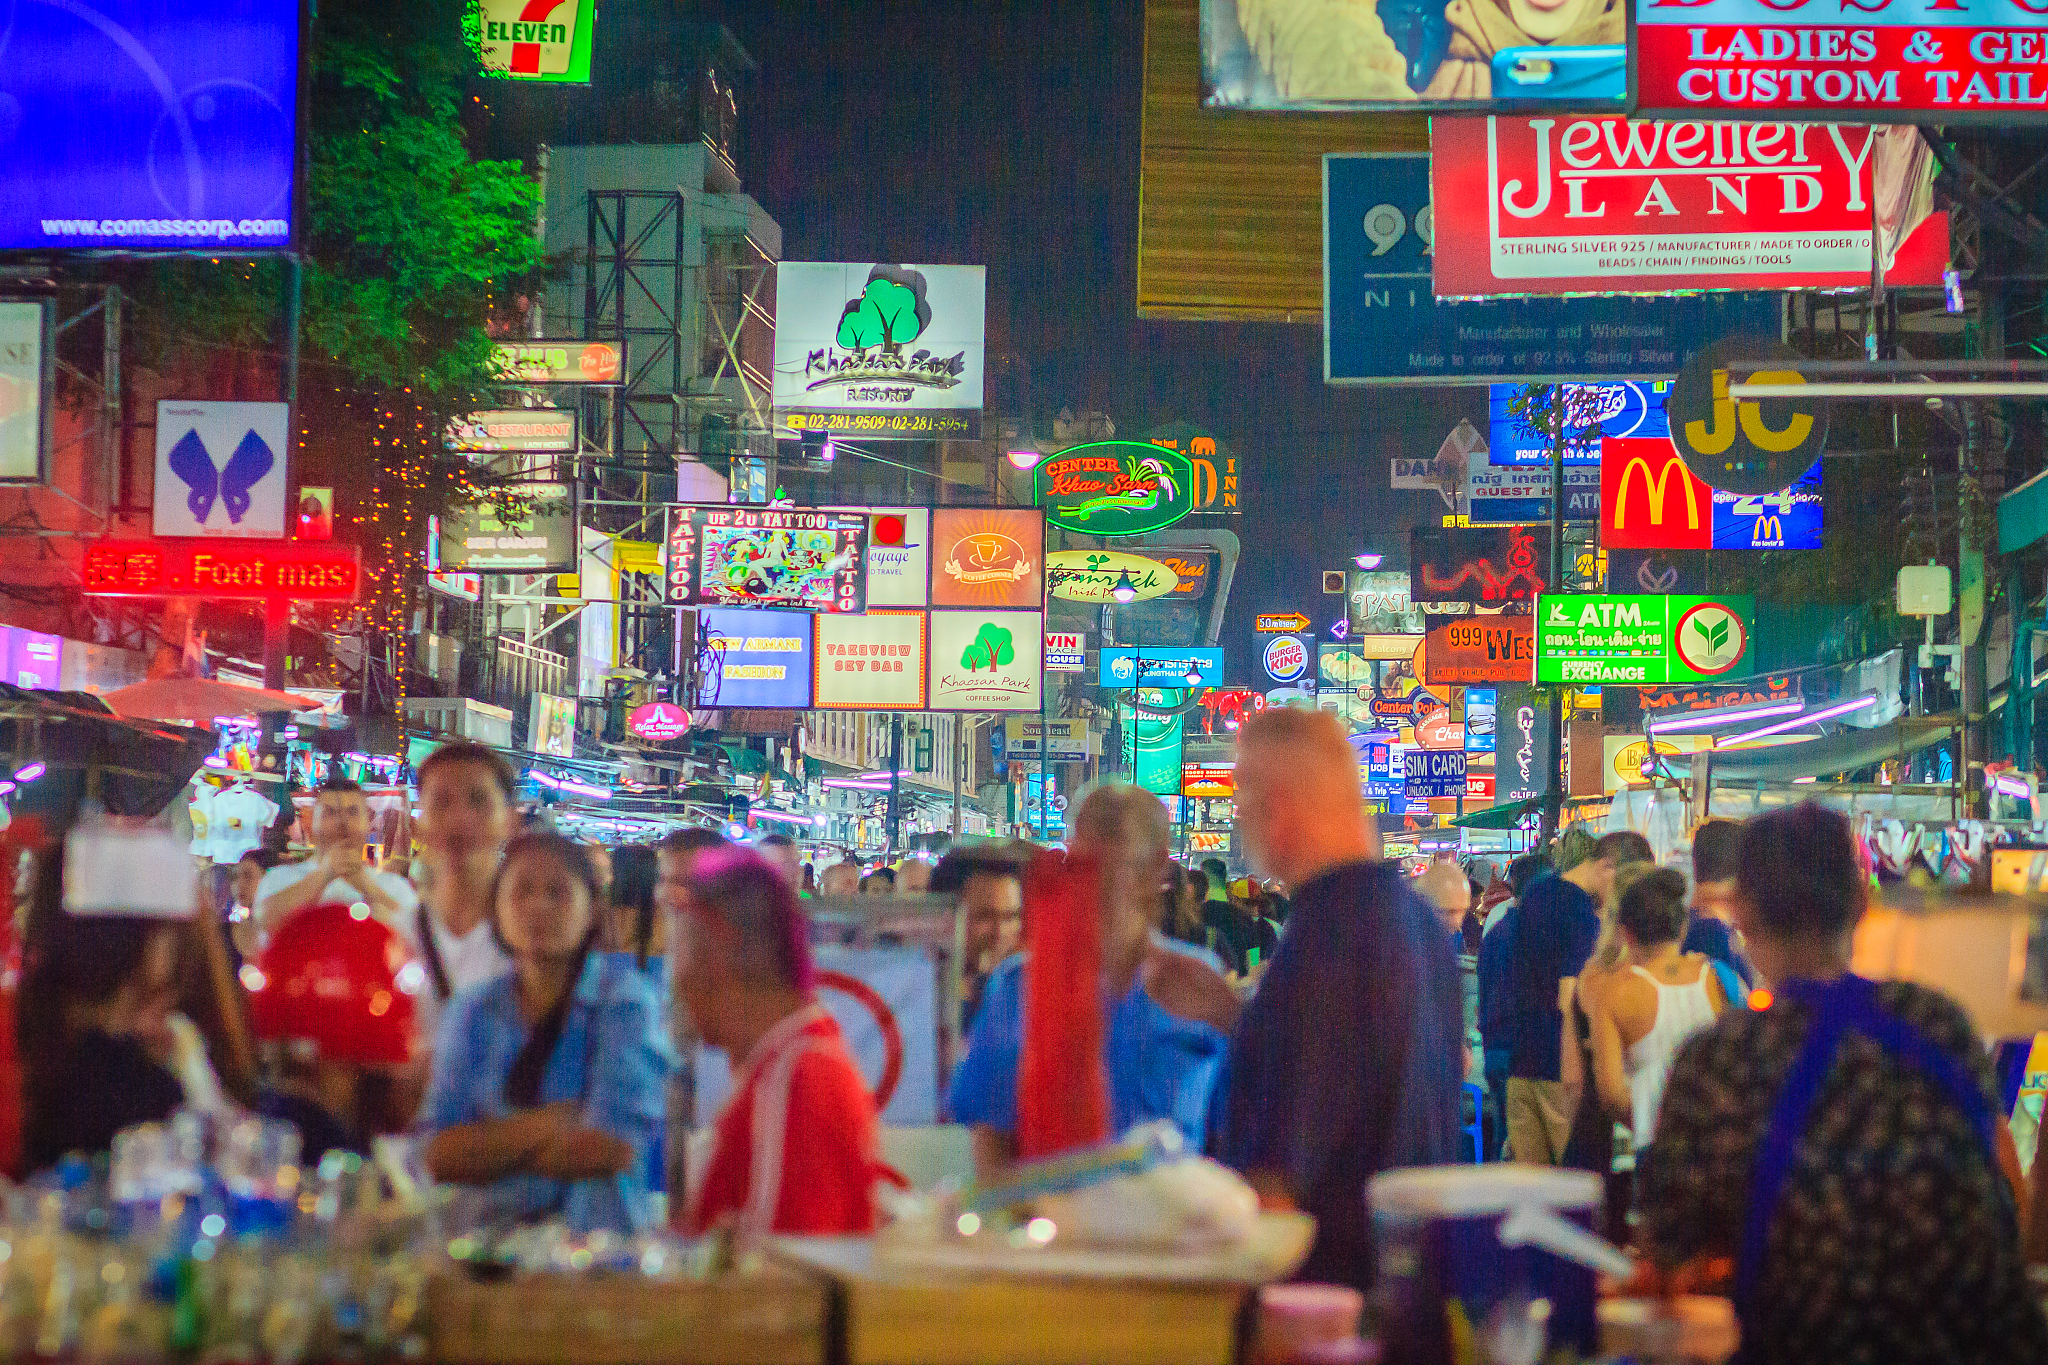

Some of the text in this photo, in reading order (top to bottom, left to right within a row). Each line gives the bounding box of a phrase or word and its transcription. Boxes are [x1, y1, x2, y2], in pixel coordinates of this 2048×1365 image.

[1687, 29, 2048, 65] LADIES & GE
[1677, 69, 1902, 103] CUSTOM
[1564, 175, 1823, 217] LAND
[40, 218, 288, 240] www.comasscorp.com
[1500, 241, 1567, 256] STERLING
[1571, 240, 1617, 254] SILVER
[1620, 240, 1646, 253] 925
[1657, 241, 1751, 252] MANUFACTURER
[1760, 239, 1794, 251] MADE
[1796, 239, 1811, 250] TO
[1813, 238, 1854, 250] ORDER
[1598, 257, 1637, 268] BEADS
[1645, 256, 1682, 267] CHAIN
[1691, 255, 1747, 266] FINDINGS
[1755, 254, 1792, 265] TOOLS
[846, 387, 915, 402] RESORT
[487, 422, 571, 437] RESTAURANT
[1046, 457, 1121, 476] CENTER
[1046, 473, 1158, 496] Khao Sarn
[1475, 487, 1533, 497] GUEST
[761, 511, 828, 529] TATTOO
[869, 552, 910, 564] oyage
[193, 553, 266, 586] Foot
[877, 568, 903, 576] TRAVEL
[963, 571, 987, 581] COFFEE
[1577, 603, 1643, 628] ATM
[743, 637, 802, 652] ARMANI
[1450, 627, 1482, 647] 999
[826, 643, 912, 657] TAKEVIEW
[1269, 644, 1301, 661] BURGER
[1371, 645, 1408, 655] Balcony
[834, 660, 904, 672] SKY BAR
[1269, 655, 1303, 673] KING
[1561, 660, 1605, 668] CURRENCY
[723, 665, 786, 680] FASHION
[1561, 667, 1646, 681] EXCHANGE
[940, 674, 1031, 690] Khaosan Park
[1374, 700, 1413, 714] Center
[1370, 763, 1389, 773] UOB
[1405, 754, 1466, 777] SIM CARD
[1406, 784, 1434, 797] UNLOCK
[1444, 784, 1467, 796] PHONE
[1510, 791, 1538, 799] CLIFF
